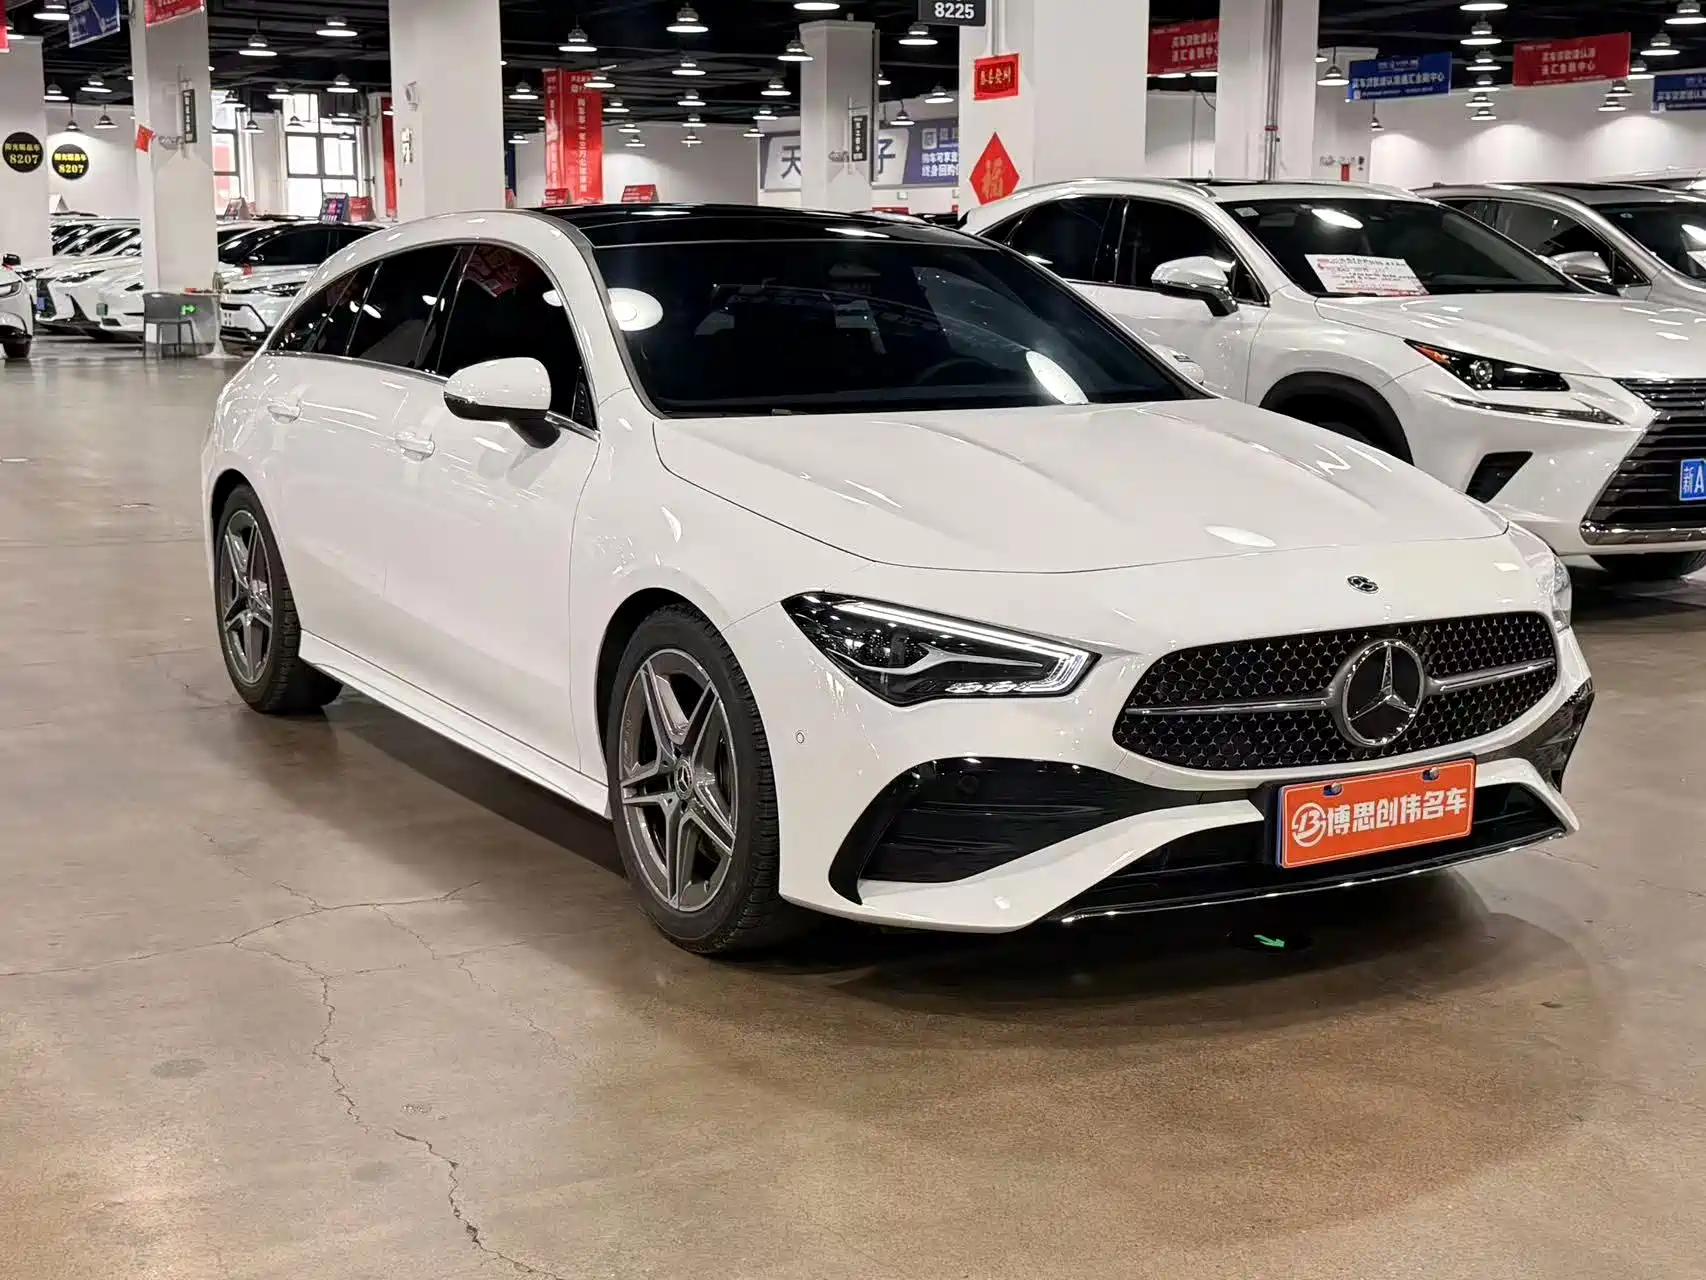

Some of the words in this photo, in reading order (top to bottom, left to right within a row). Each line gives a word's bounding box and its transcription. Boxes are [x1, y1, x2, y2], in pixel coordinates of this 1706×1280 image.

[934, 2, 975, 19] 8225
[10, 154, 39, 165] 8207
[877, 138, 896, 174] 子
[59, 164, 84, 174] 8207
[1327, 787, 1468, 837] 博思创伟名车
